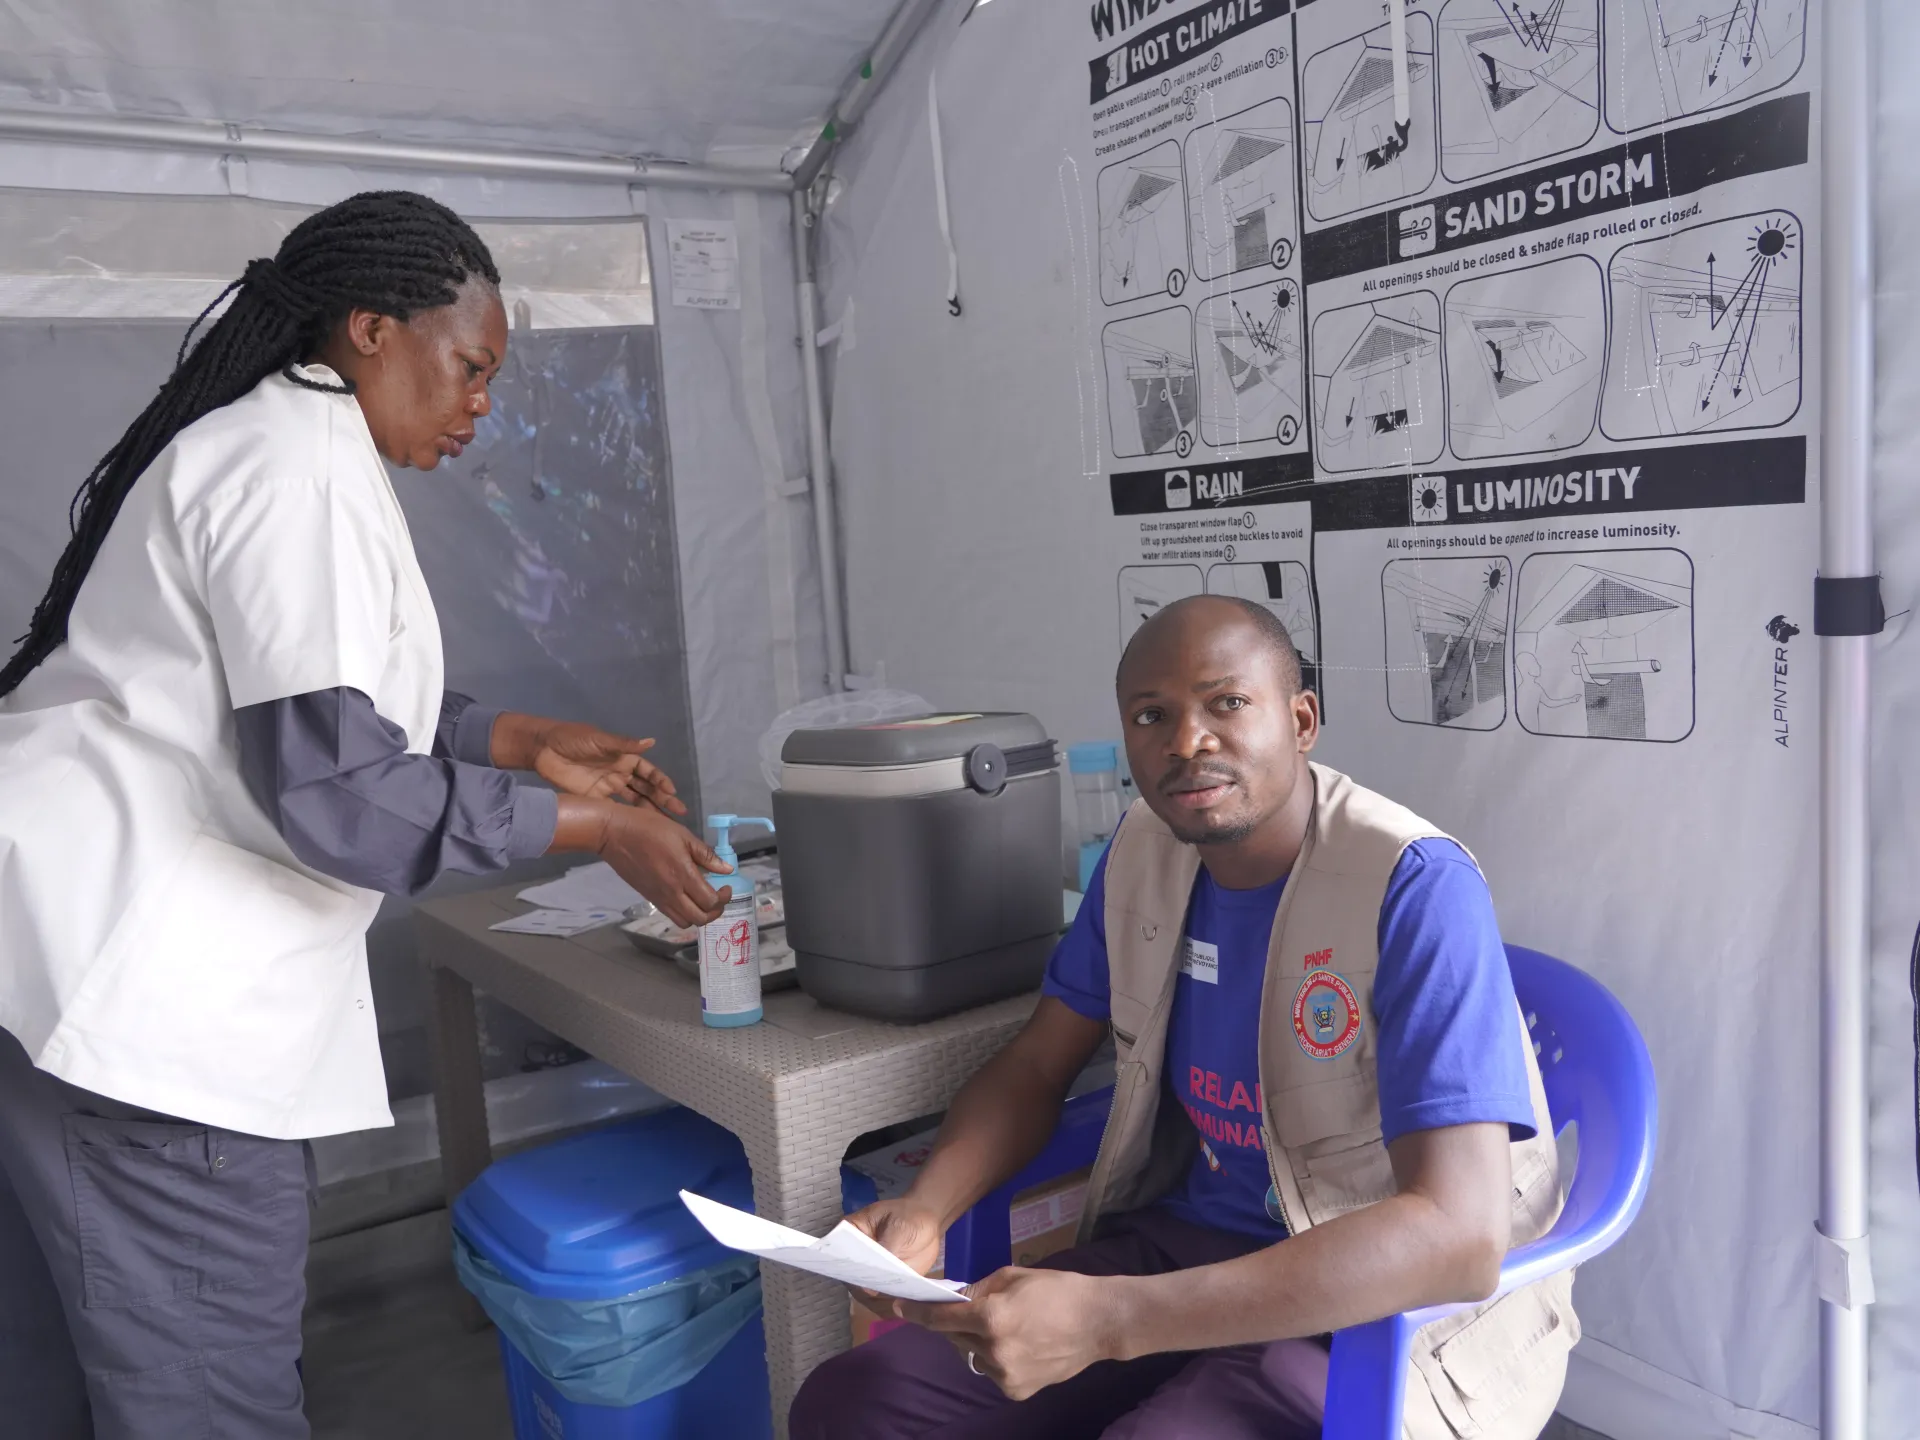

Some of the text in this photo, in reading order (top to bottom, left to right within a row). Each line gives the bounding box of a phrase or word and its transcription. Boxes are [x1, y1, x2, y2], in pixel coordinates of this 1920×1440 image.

[1091, 0, 1175, 42] WIN
[1131, 0, 1262, 73] HOT CLIMATE
[1107, 102, 1124, 117] gable
[1126, 88, 1160, 107] ventilation
[1109, 112, 1146, 133] transparent
[1147, 101, 1169, 118] window
[1170, 96, 1182, 108] flap
[1207, 76, 1222, 89] eave
[1224, 59, 1264, 82] ventilation
[1095, 143, 1116, 156] Create
[1117, 134, 1137, 149] shades
[1139, 127, 1151, 139] with
[1152, 119, 1172, 134] window
[1174, 112, 1185, 124] flap
[1445, 153, 1653, 238] SAND STORM
[1363, 201, 1702, 292] All openings should be closed & shade flap rolled or closed.
[1195, 471, 1243, 499] RAIN
[1457, 466, 1641, 513] LUMINOSITY
[1140, 523, 1158, 532] Close
[1159, 520, 1199, 531] transparent
[1200, 517, 1226, 528] window
[1228, 516, 1242, 527] flap
[1162, 534, 1203, 547] groundsheet
[1205, 534, 1217, 543] and
[1219, 533, 1237, 542] close
[1239, 531, 1270, 541] buckles
[1272, 530, 1279, 540] to
[1281, 528, 1303, 539] avoid
[1387, 523, 1680, 550] All openings should be opened to increase luminosity.
[1202, 548, 1223, 558] inside
[1774, 647, 1789, 748] ALPINTER
[1303, 948, 1333, 970] PNHF
[1333, 1026, 1358, 1054] GENERAL
[1183, 1101, 1264, 1151] MMUNA
